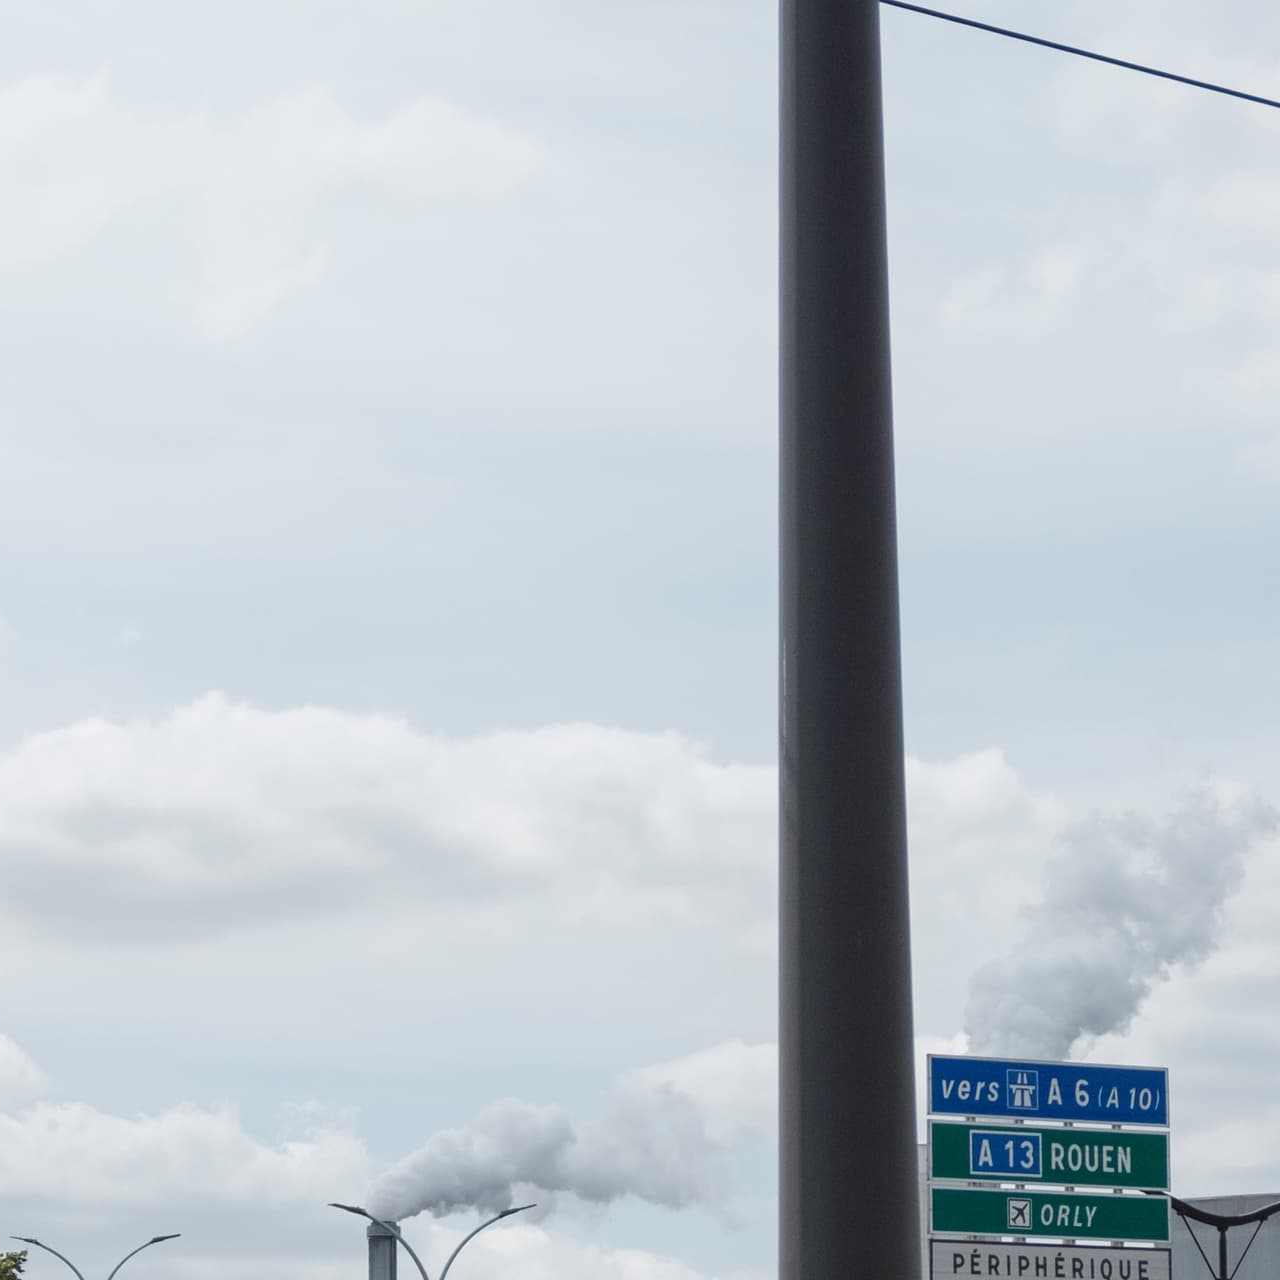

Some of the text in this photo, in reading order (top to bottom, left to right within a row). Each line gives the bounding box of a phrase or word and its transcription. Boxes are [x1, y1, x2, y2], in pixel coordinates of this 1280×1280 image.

[942, 1079, 999, 1101] vers
[1005, 1140, 1034, 1168] 13
[1051, 1142, 1131, 1173] ROUEN
[1040, 1204, 1097, 1227] ORLY
[953, 1249, 1149, 1280] PÉRIPHÉRIQUE
